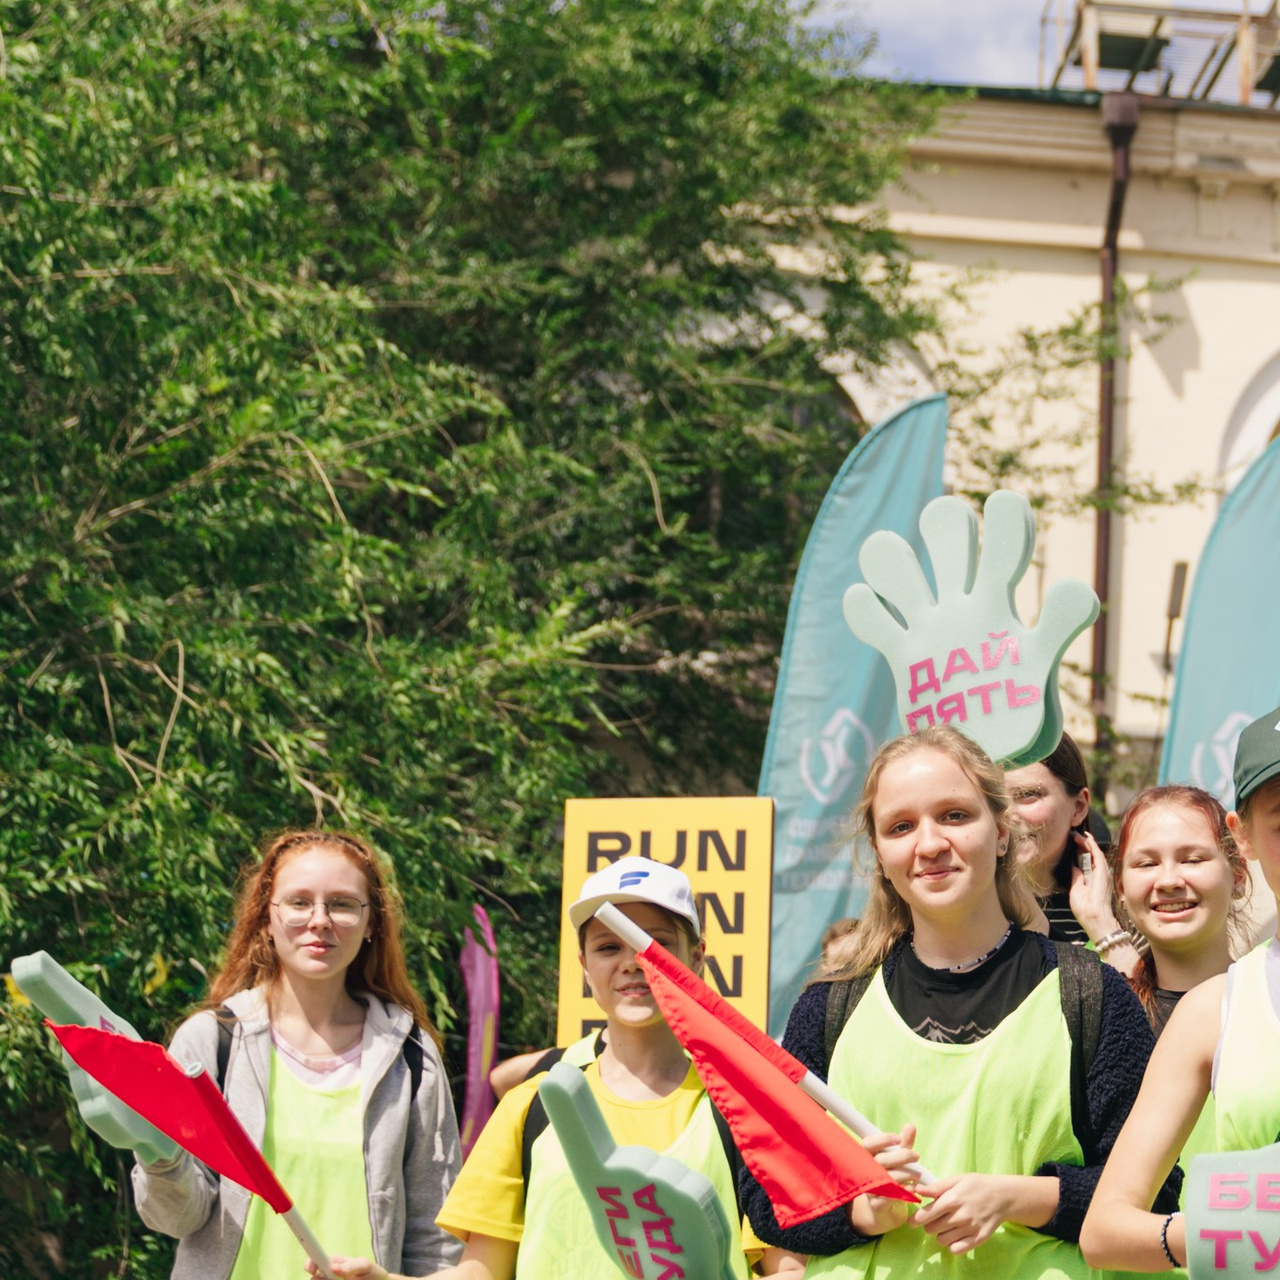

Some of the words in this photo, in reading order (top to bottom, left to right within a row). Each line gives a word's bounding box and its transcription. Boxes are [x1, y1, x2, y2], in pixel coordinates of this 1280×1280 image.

[907, 629, 1020, 704] ДАЙ
[905, 678, 1041, 735] ПЯТЬ
[587, 830, 746, 873] RUN
